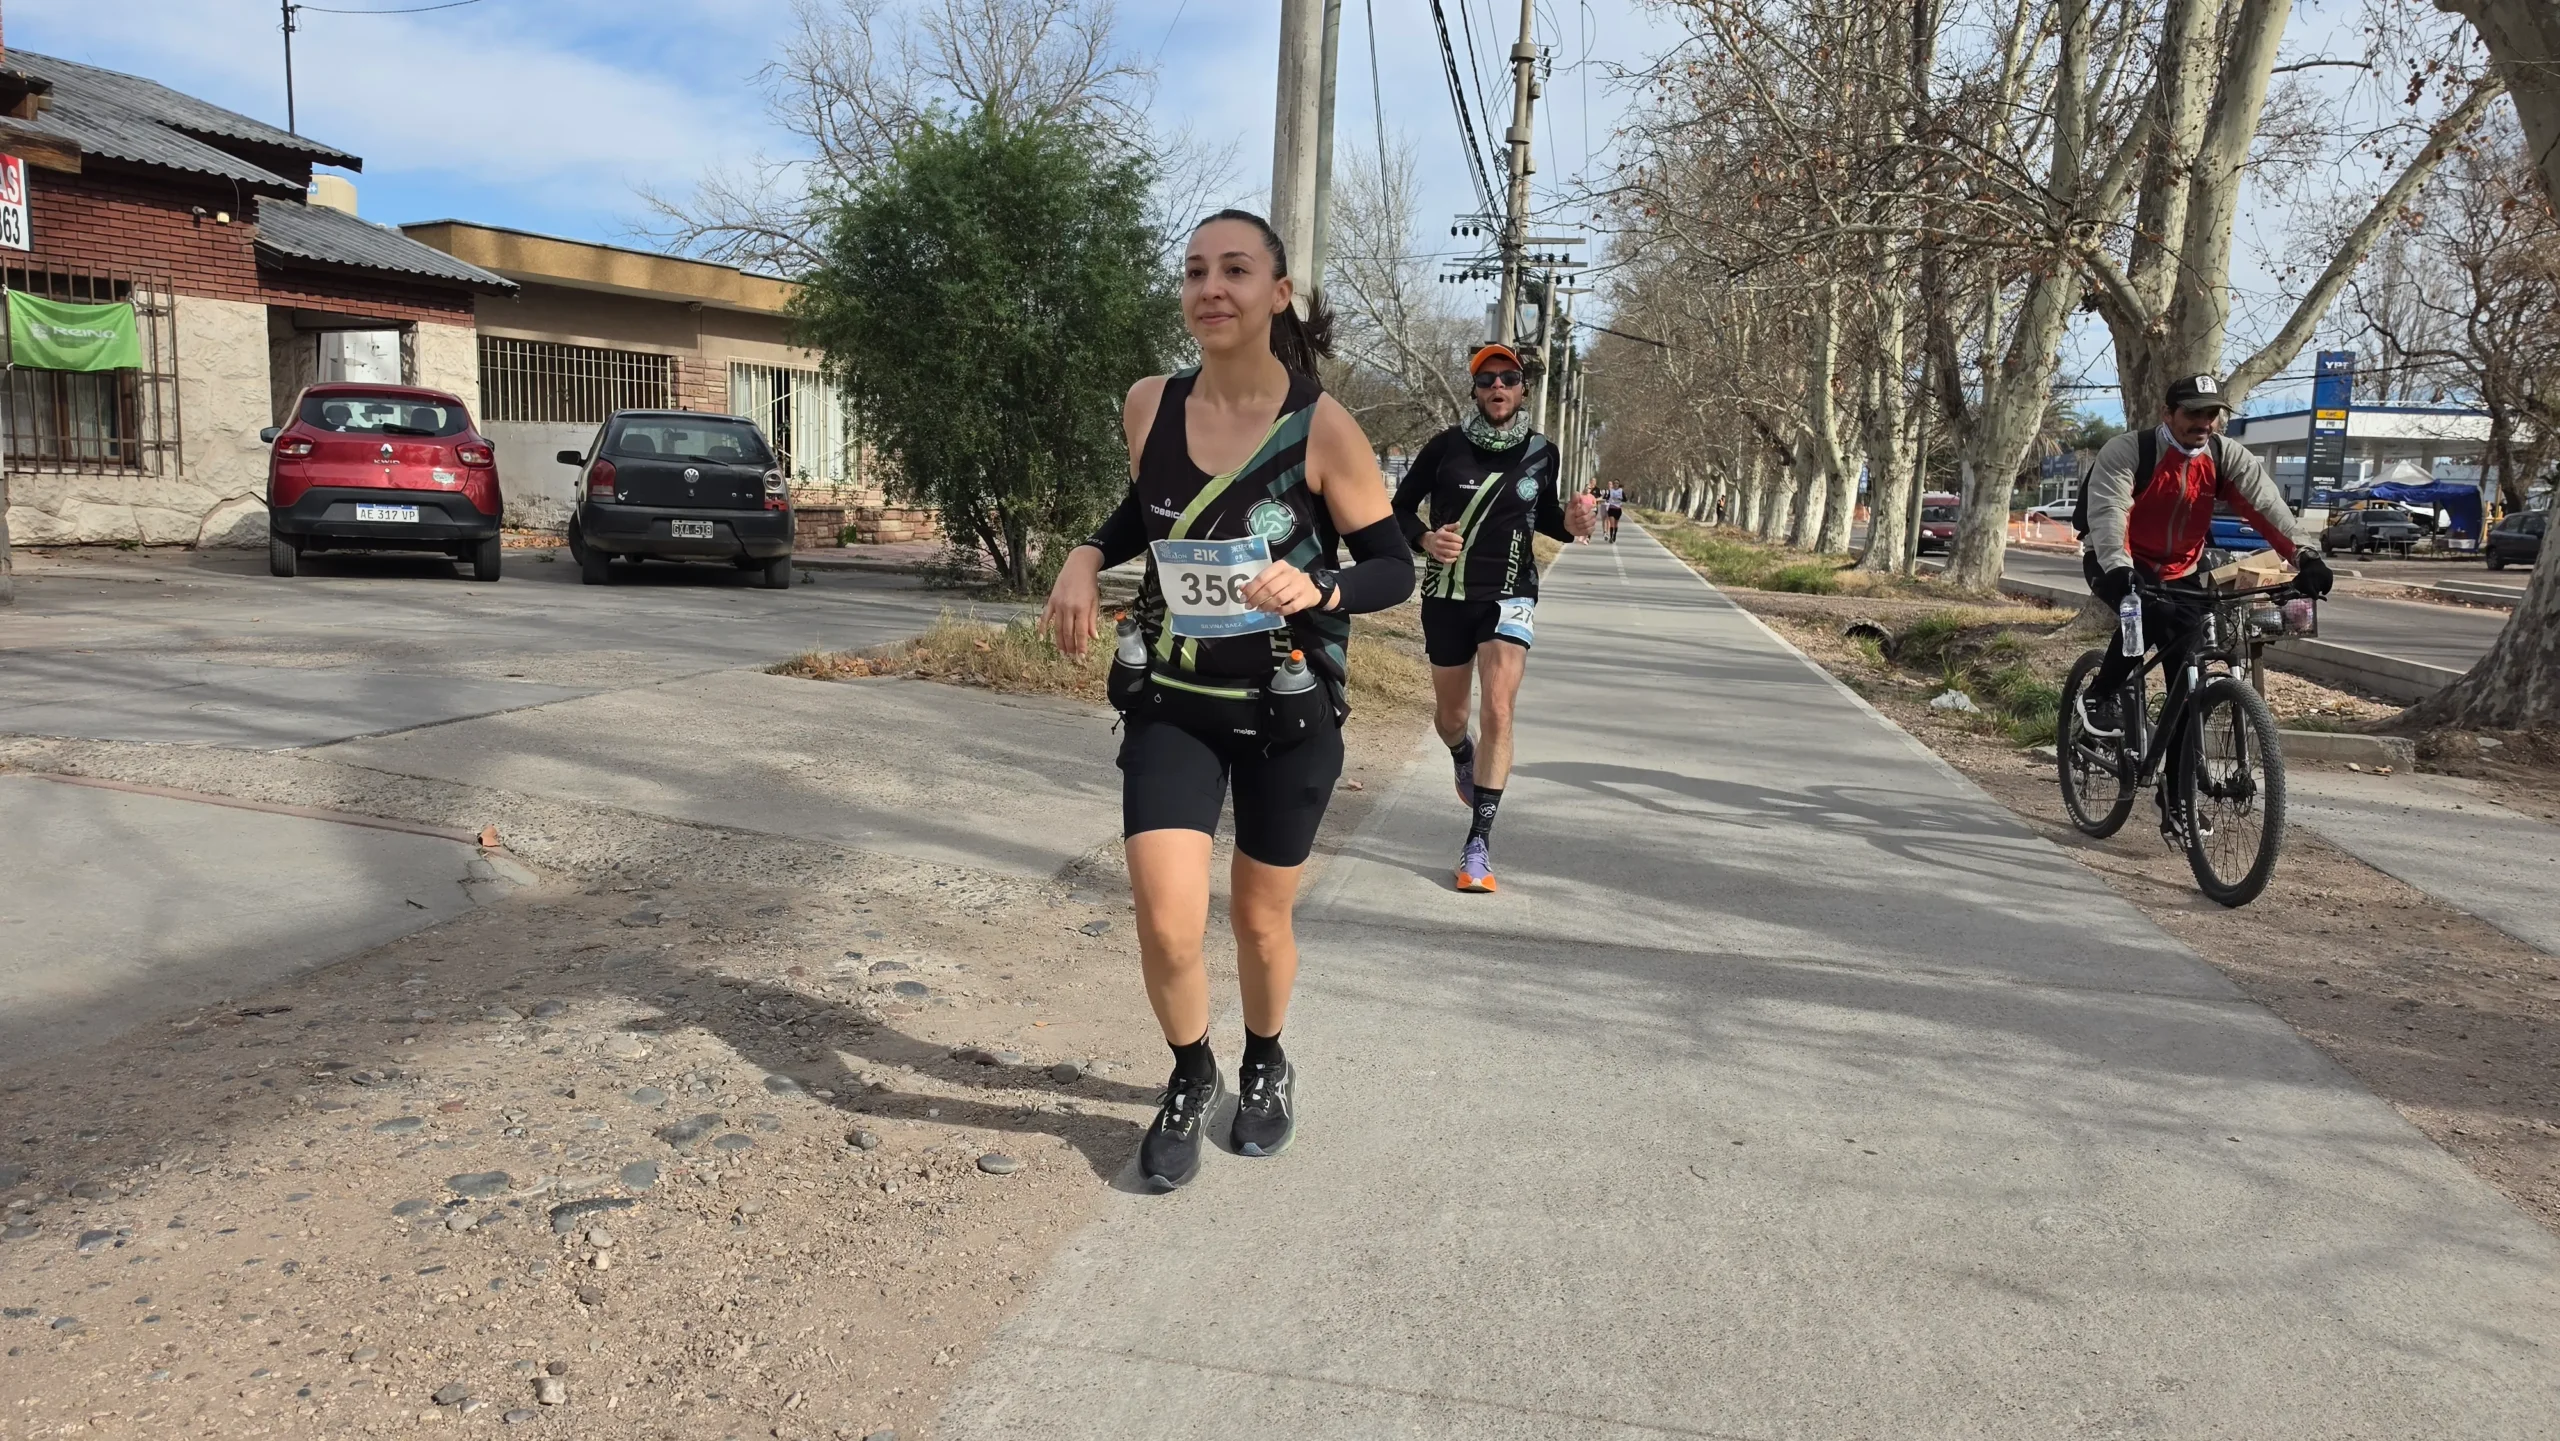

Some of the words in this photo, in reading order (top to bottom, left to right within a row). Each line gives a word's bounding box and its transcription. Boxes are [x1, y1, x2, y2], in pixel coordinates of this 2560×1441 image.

[0, 205, 20, 245] 63
[360, 509, 374, 519] AE
[377, 510, 398, 520] 317
[402, 512, 415, 520] VP
[673, 525, 690, 535] GXA
[1193, 548, 1220, 562] 21K
[1180, 572, 1251, 606] 356
[1511, 605, 1535, 630] 27
